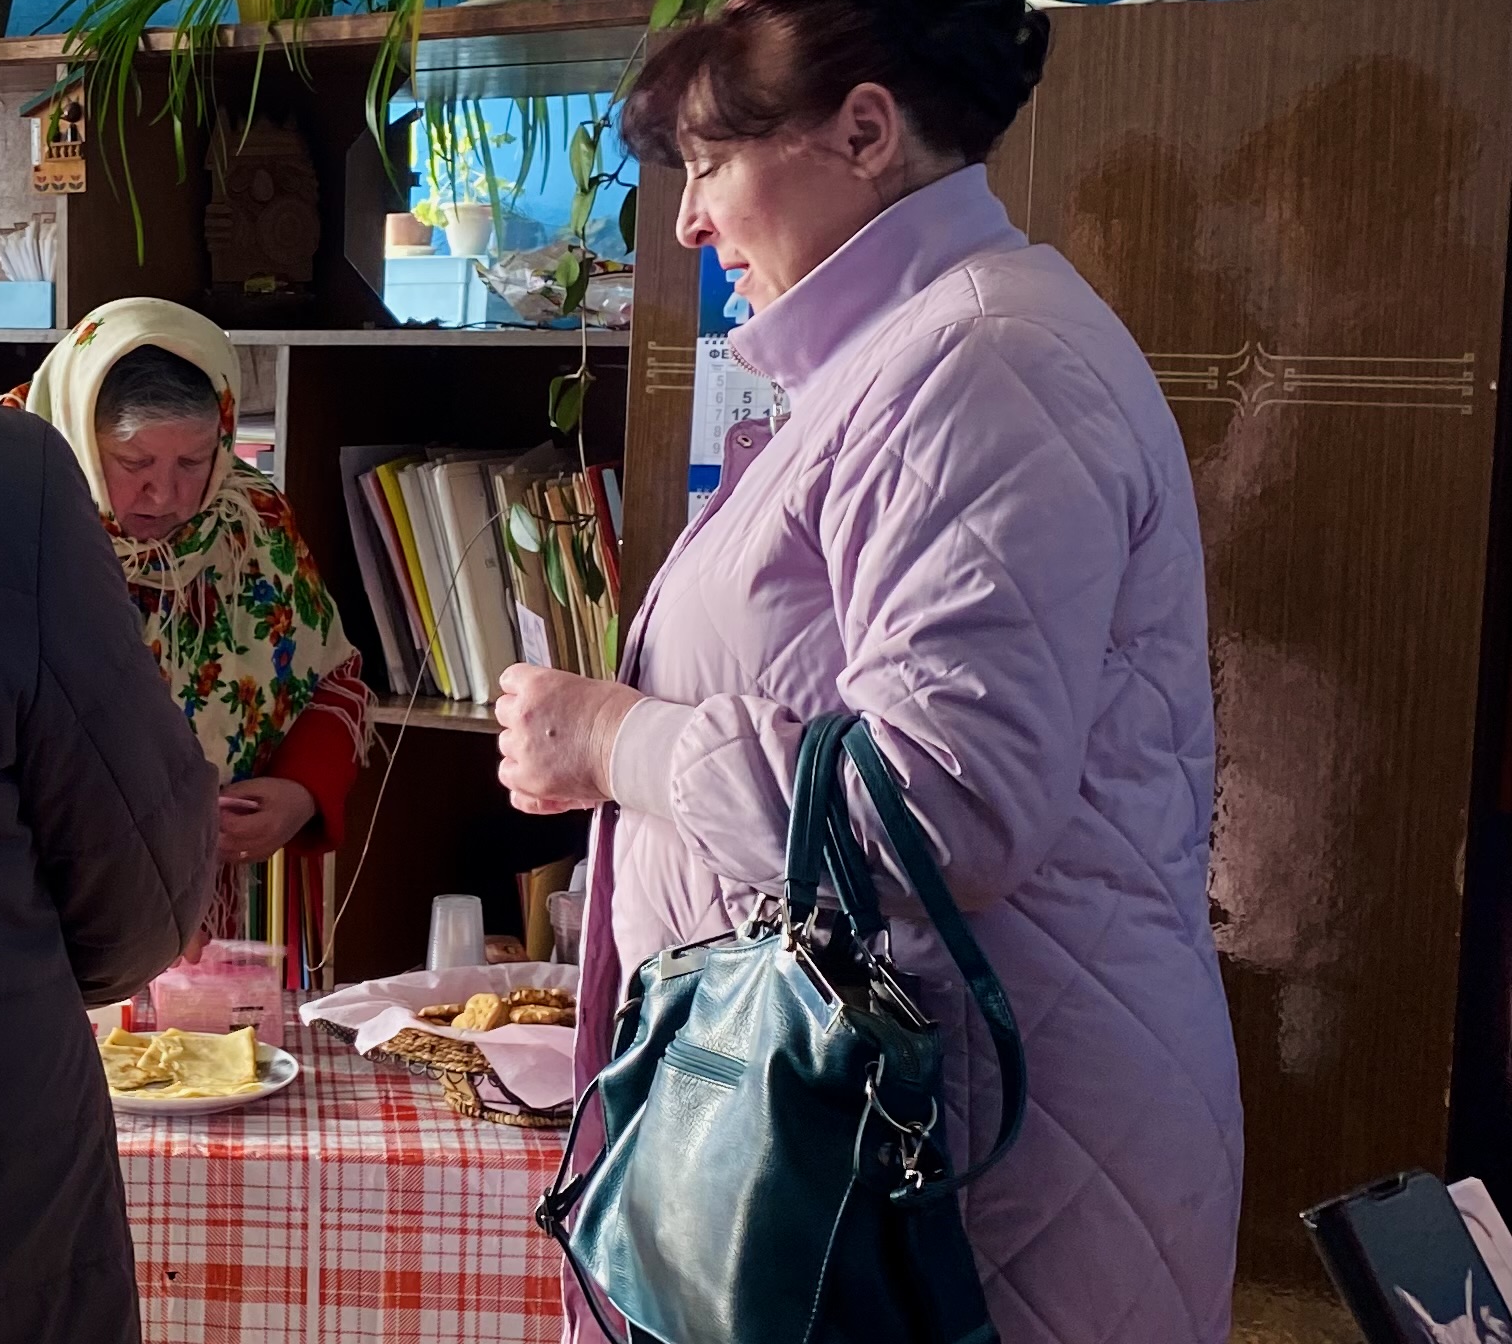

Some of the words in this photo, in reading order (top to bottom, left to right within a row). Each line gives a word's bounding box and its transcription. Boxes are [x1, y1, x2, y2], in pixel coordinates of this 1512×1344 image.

[716, 375, 724, 387] 5
[715, 392, 724, 404] 6
[742, 391, 752, 404] 5
[715, 409, 723, 421] 7
[731, 408, 752, 420] 12
[713, 425, 722, 437] 8
[713, 442, 721, 454] 9
